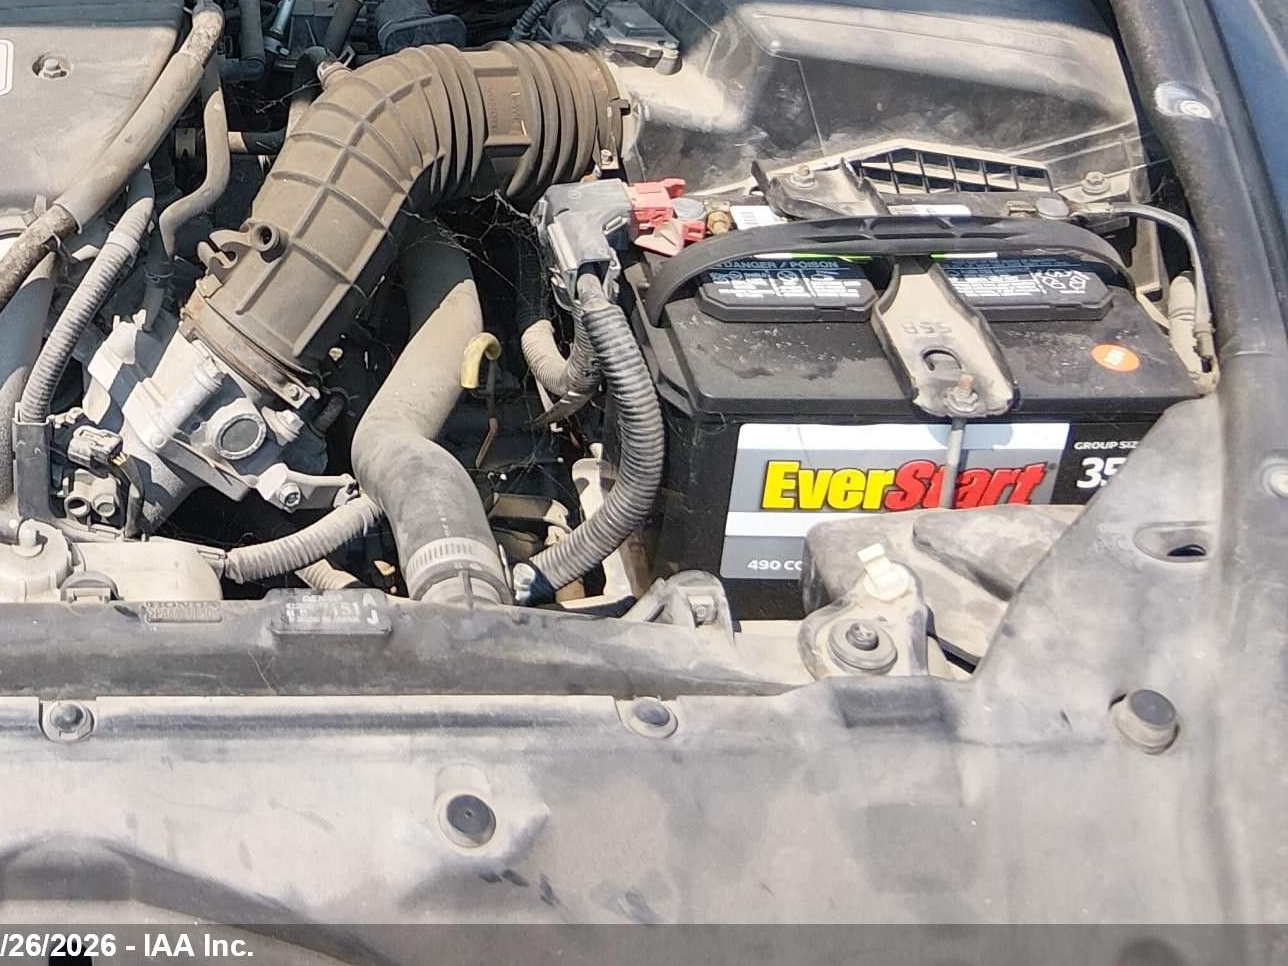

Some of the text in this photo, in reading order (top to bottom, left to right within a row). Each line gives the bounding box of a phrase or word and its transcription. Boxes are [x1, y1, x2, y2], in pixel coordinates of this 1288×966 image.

[724, 260, 776, 269] DANGER
[789, 260, 839, 269] POISON
[1074, 440, 1140, 450] GROUP SIZ
[1076, 457, 1127, 488] 35
[747, 559, 803, 571] 490 CC
[366, 610, 379, 625] J
